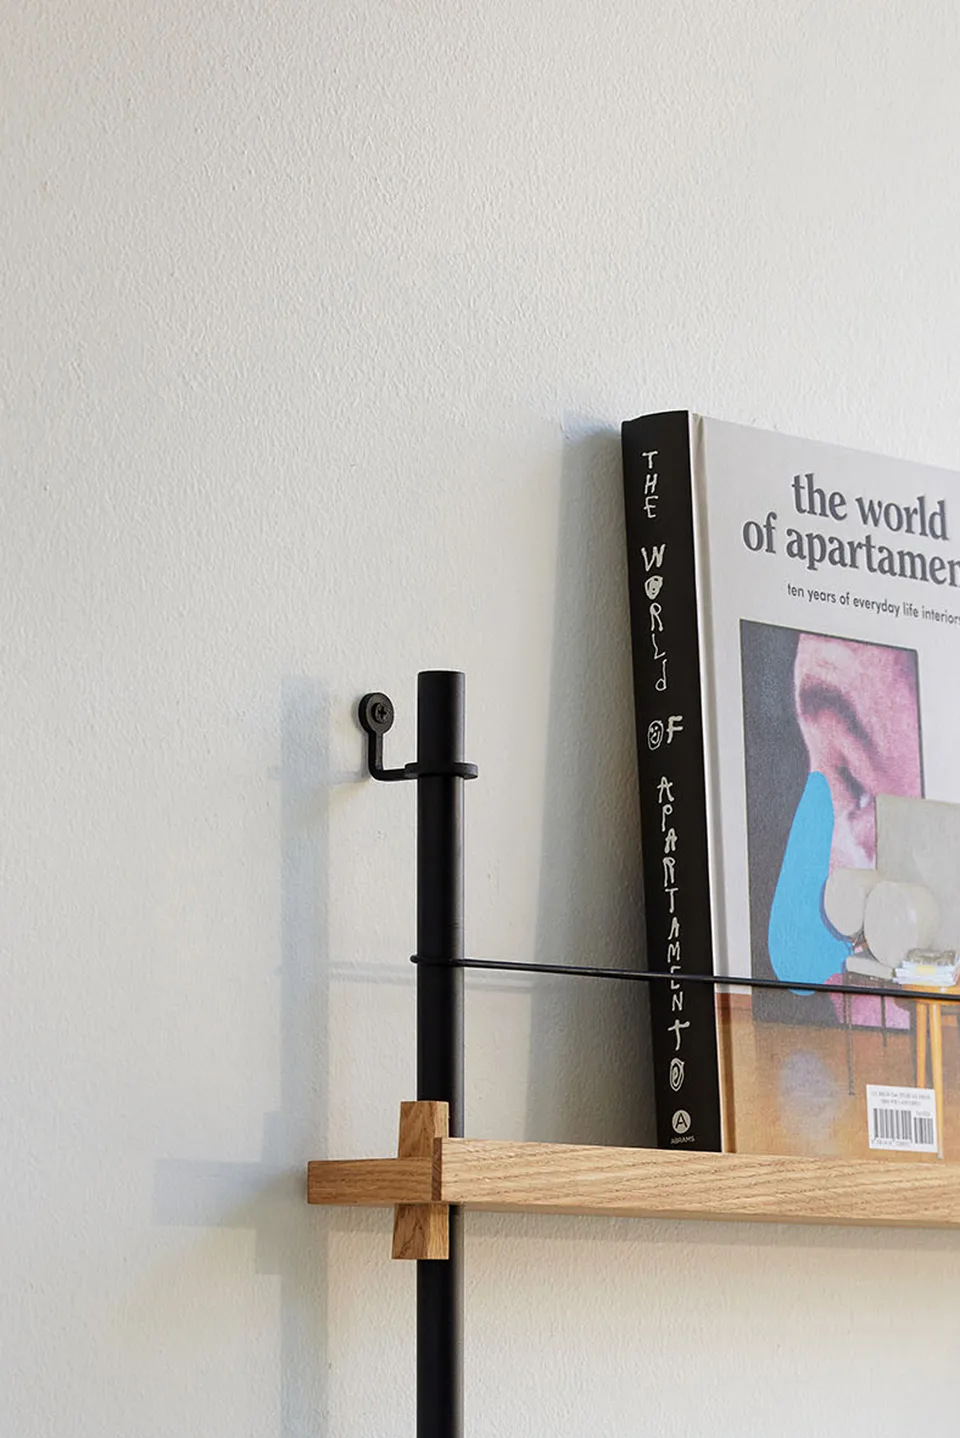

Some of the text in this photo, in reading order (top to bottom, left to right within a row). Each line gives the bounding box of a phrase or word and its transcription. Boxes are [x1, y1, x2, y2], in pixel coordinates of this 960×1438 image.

[642, 450, 659, 519] THE
[791, 473, 950, 541] the world
[742, 511, 777, 554] of
[787, 584, 805, 598] ten
[807, 588, 837, 603] years
[839, 592, 851, 606] of
[853, 598, 901, 618] everyday
[902, 602, 919, 619] life
[647, 715, 684, 751] OF
